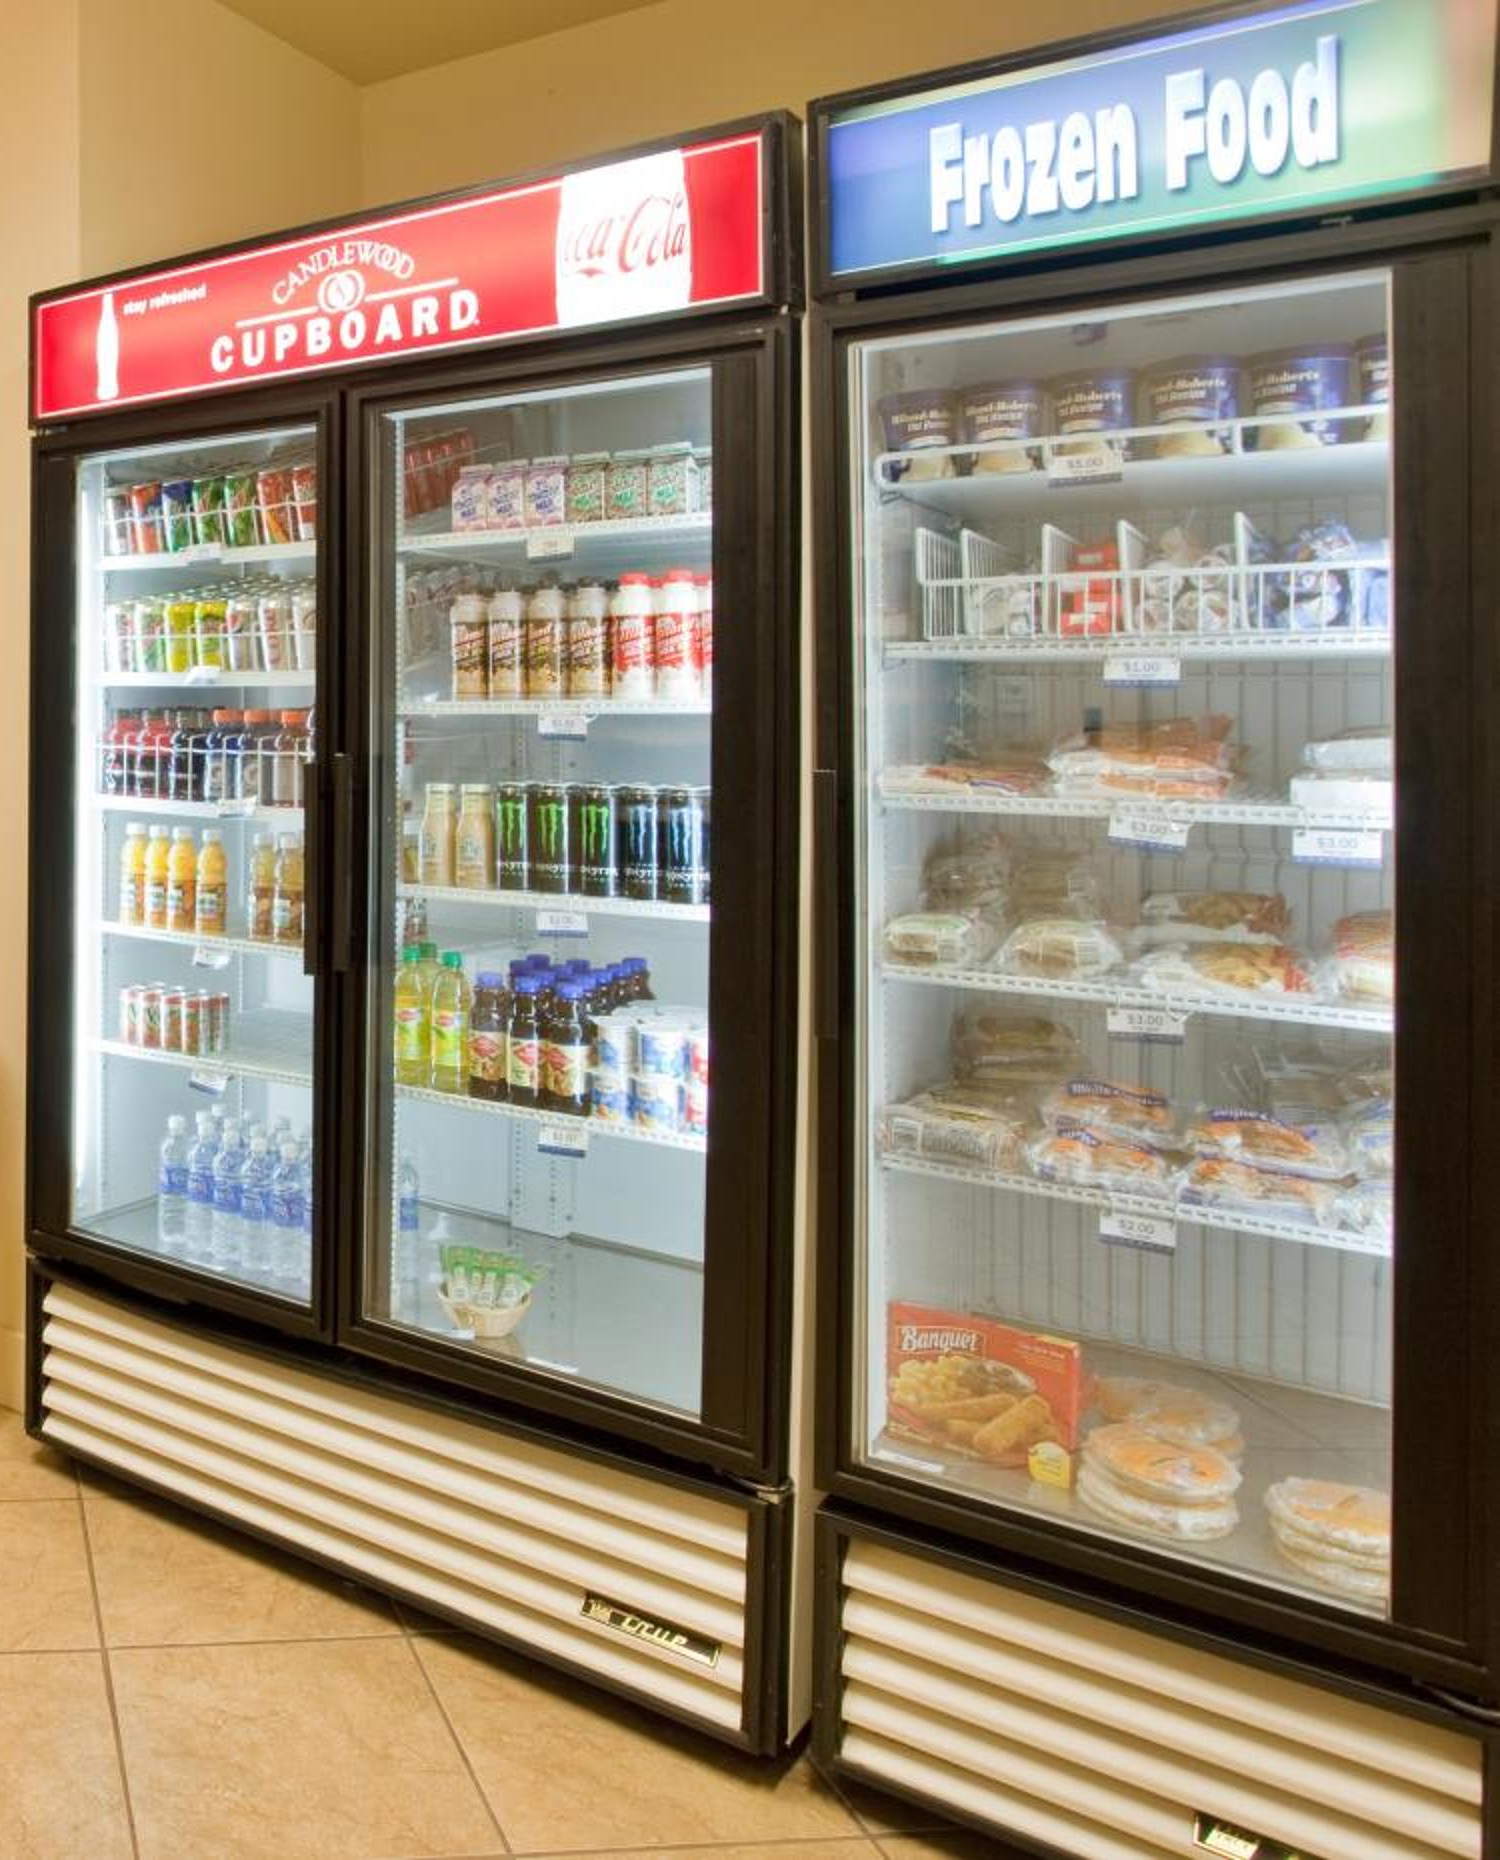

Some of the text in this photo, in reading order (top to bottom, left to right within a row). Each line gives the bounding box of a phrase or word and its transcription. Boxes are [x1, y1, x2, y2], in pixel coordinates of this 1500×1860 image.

[929, 34, 1341, 234] Frozen Food
[123, 282, 207, 316] stay refreshed
[272, 240, 415, 304] CANDLEWOOD
[211, 289, 479, 374] CUPBOARD
[900, 1326, 979, 1354] Banquet
